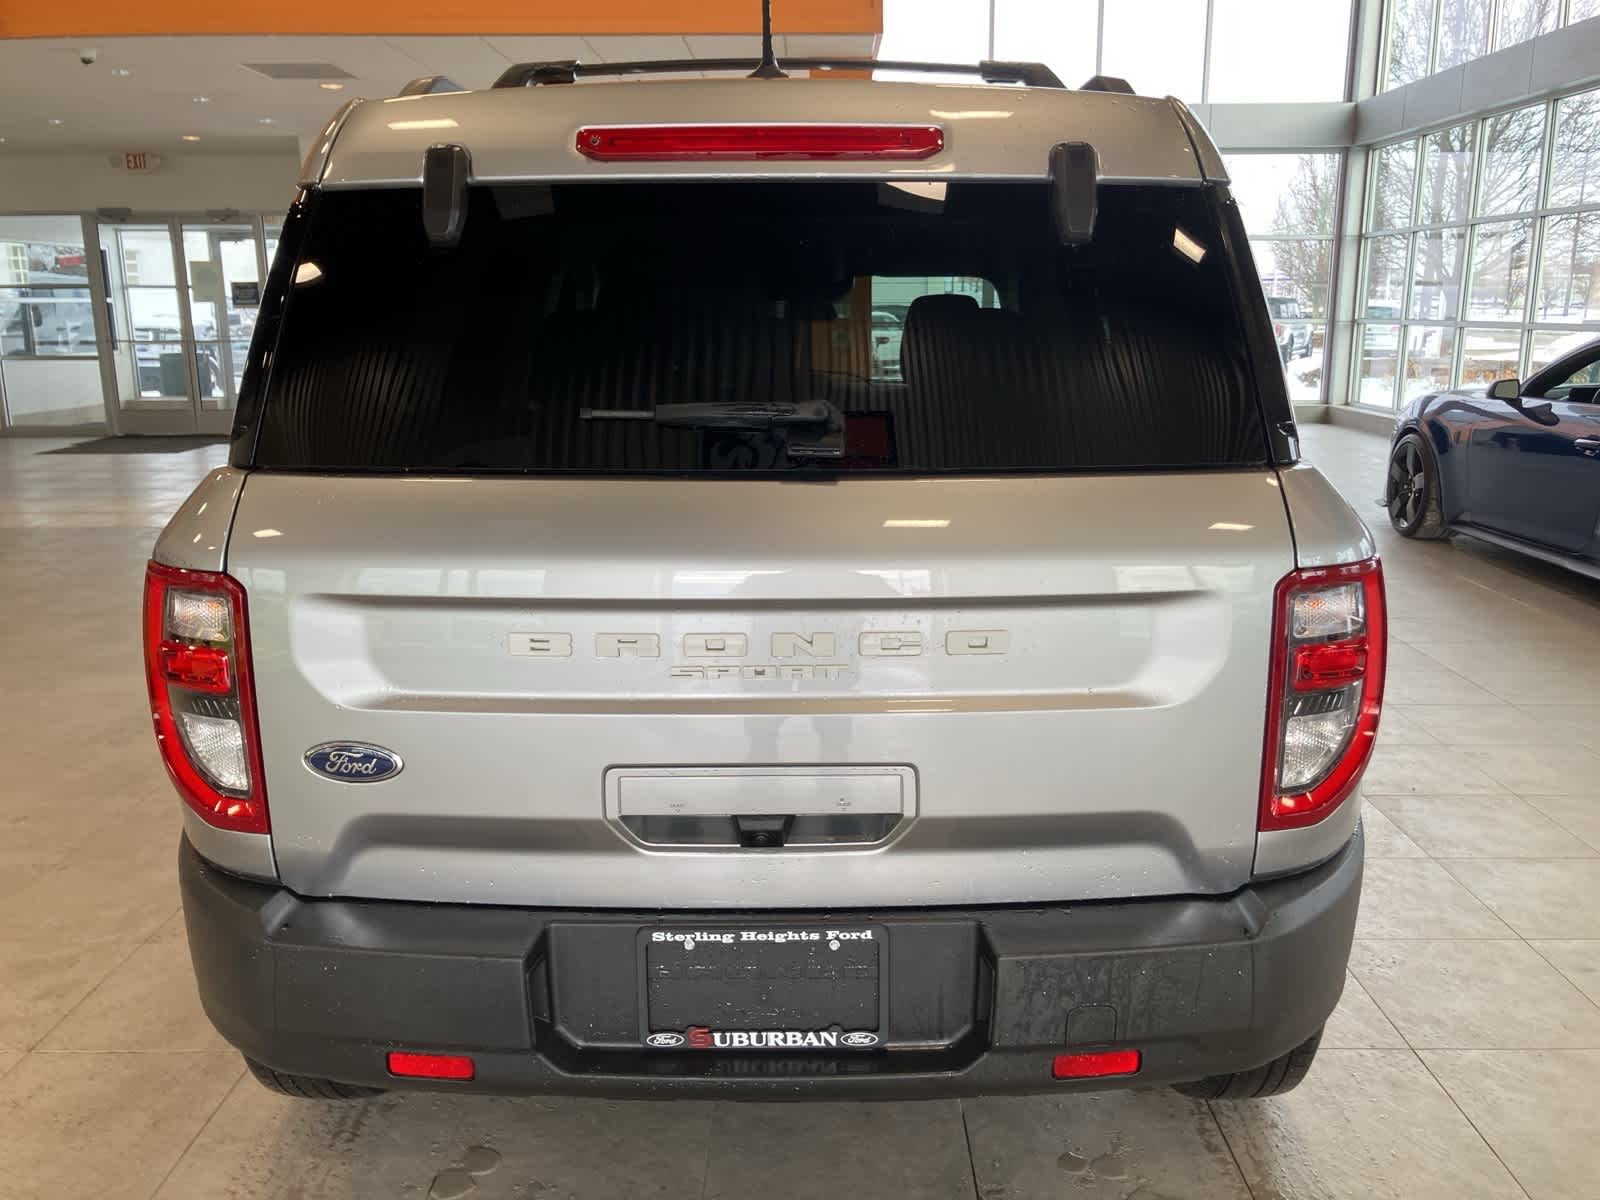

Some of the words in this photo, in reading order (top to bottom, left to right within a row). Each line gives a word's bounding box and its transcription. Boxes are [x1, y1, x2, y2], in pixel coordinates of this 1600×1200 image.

[126, 152, 145, 169] EXIT
[507, 629, 1009, 657] BRONCO
[670, 664, 849, 680] SPORT
[651, 931, 735, 943] Sterling
[740, 931, 820, 942] Heights
[826, 930, 873, 941] Ford
[688, 1027, 838, 1048] SUBURBAN
